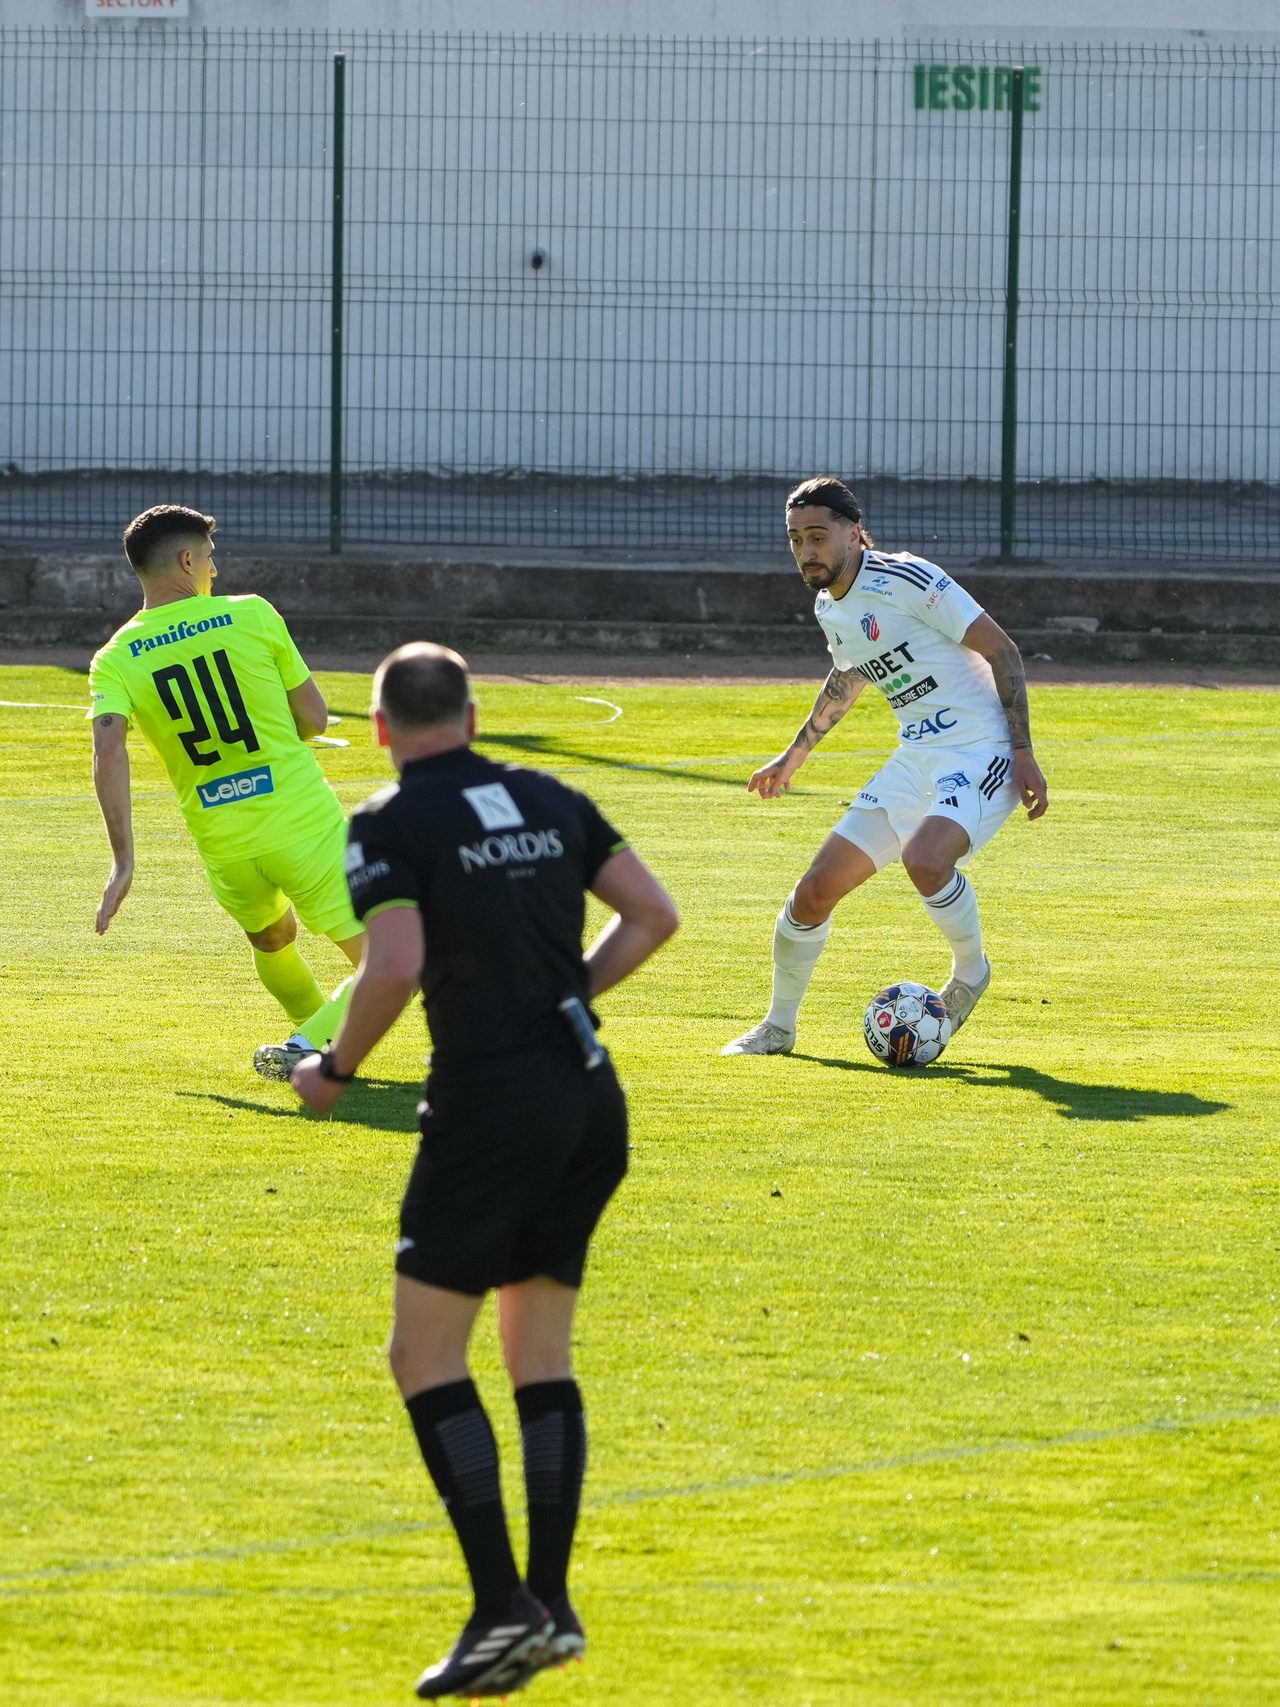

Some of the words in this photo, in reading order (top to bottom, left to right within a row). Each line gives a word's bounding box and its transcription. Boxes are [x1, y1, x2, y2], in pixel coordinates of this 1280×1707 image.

[914, 64, 1041, 111] IESIRE
[128, 613, 234, 658] Panifcom
[151, 648, 261, 766] 24
[860, 792, 879, 804] stra
[458, 828, 564, 875] NORDIS
